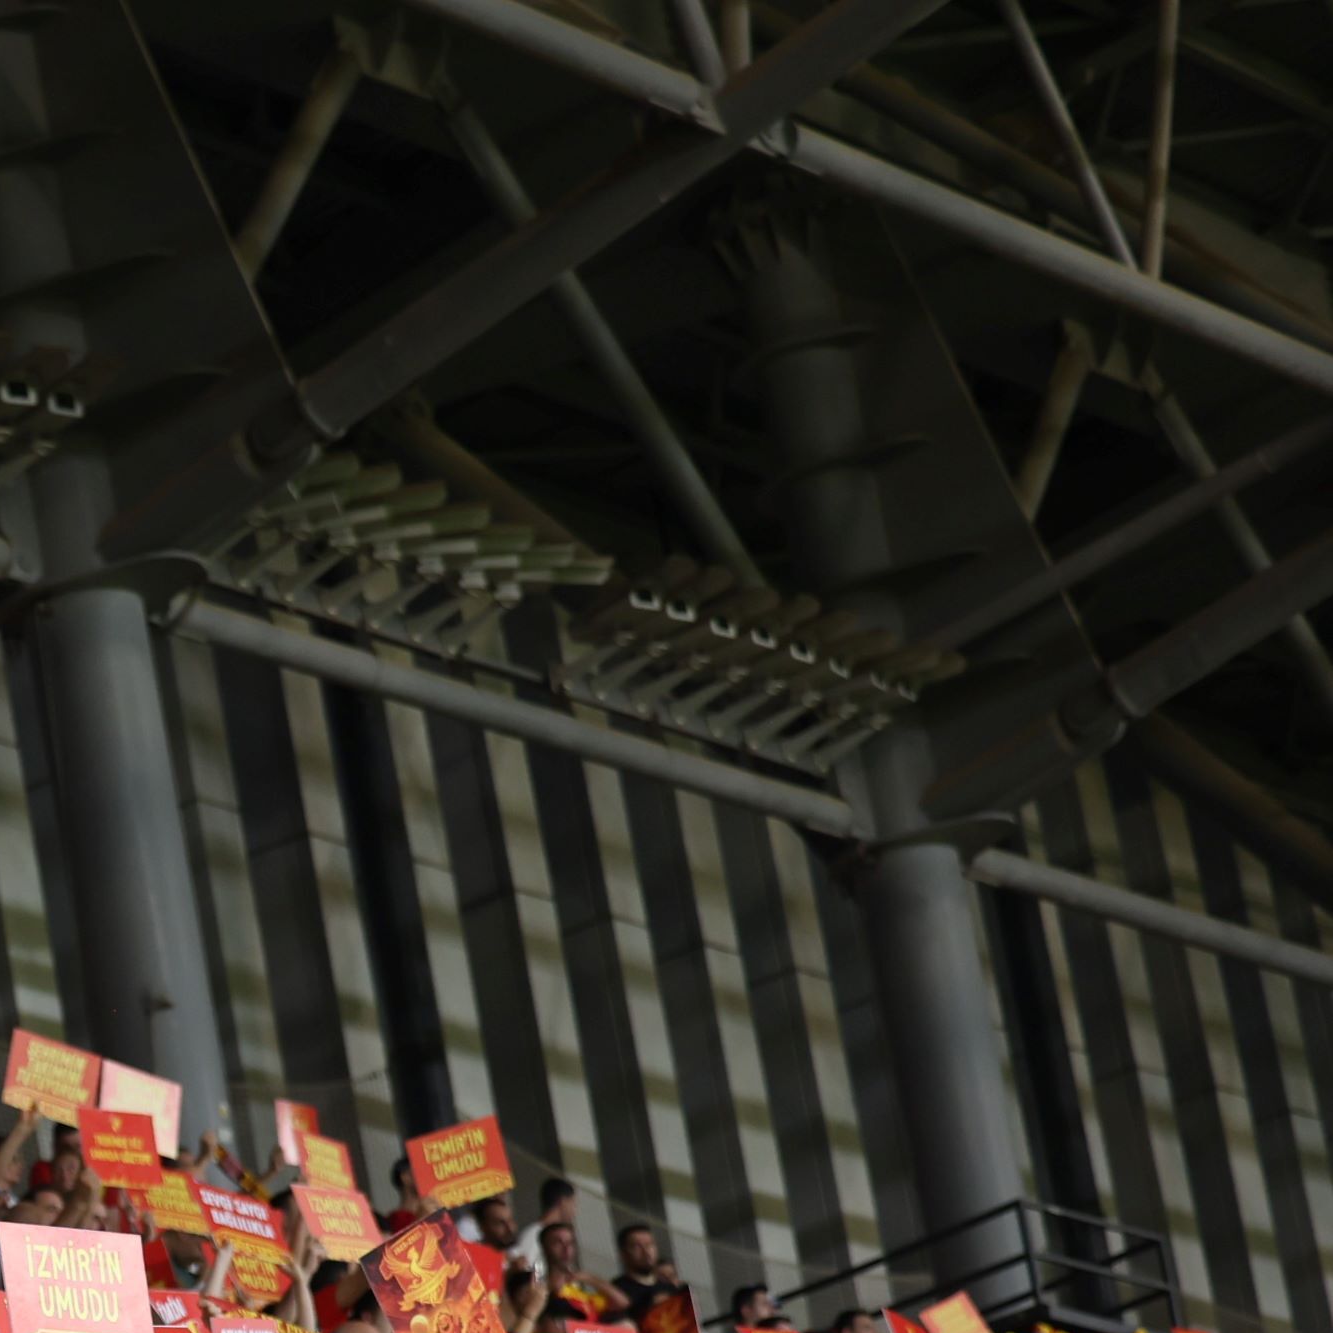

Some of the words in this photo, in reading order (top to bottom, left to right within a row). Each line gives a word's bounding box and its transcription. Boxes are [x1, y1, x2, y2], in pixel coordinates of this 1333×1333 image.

[433, 1151, 485, 1181] UMUDU
[25, 1235, 122, 1284] İZMİR'İN
[39, 1285, 119, 1322] UMUDU
